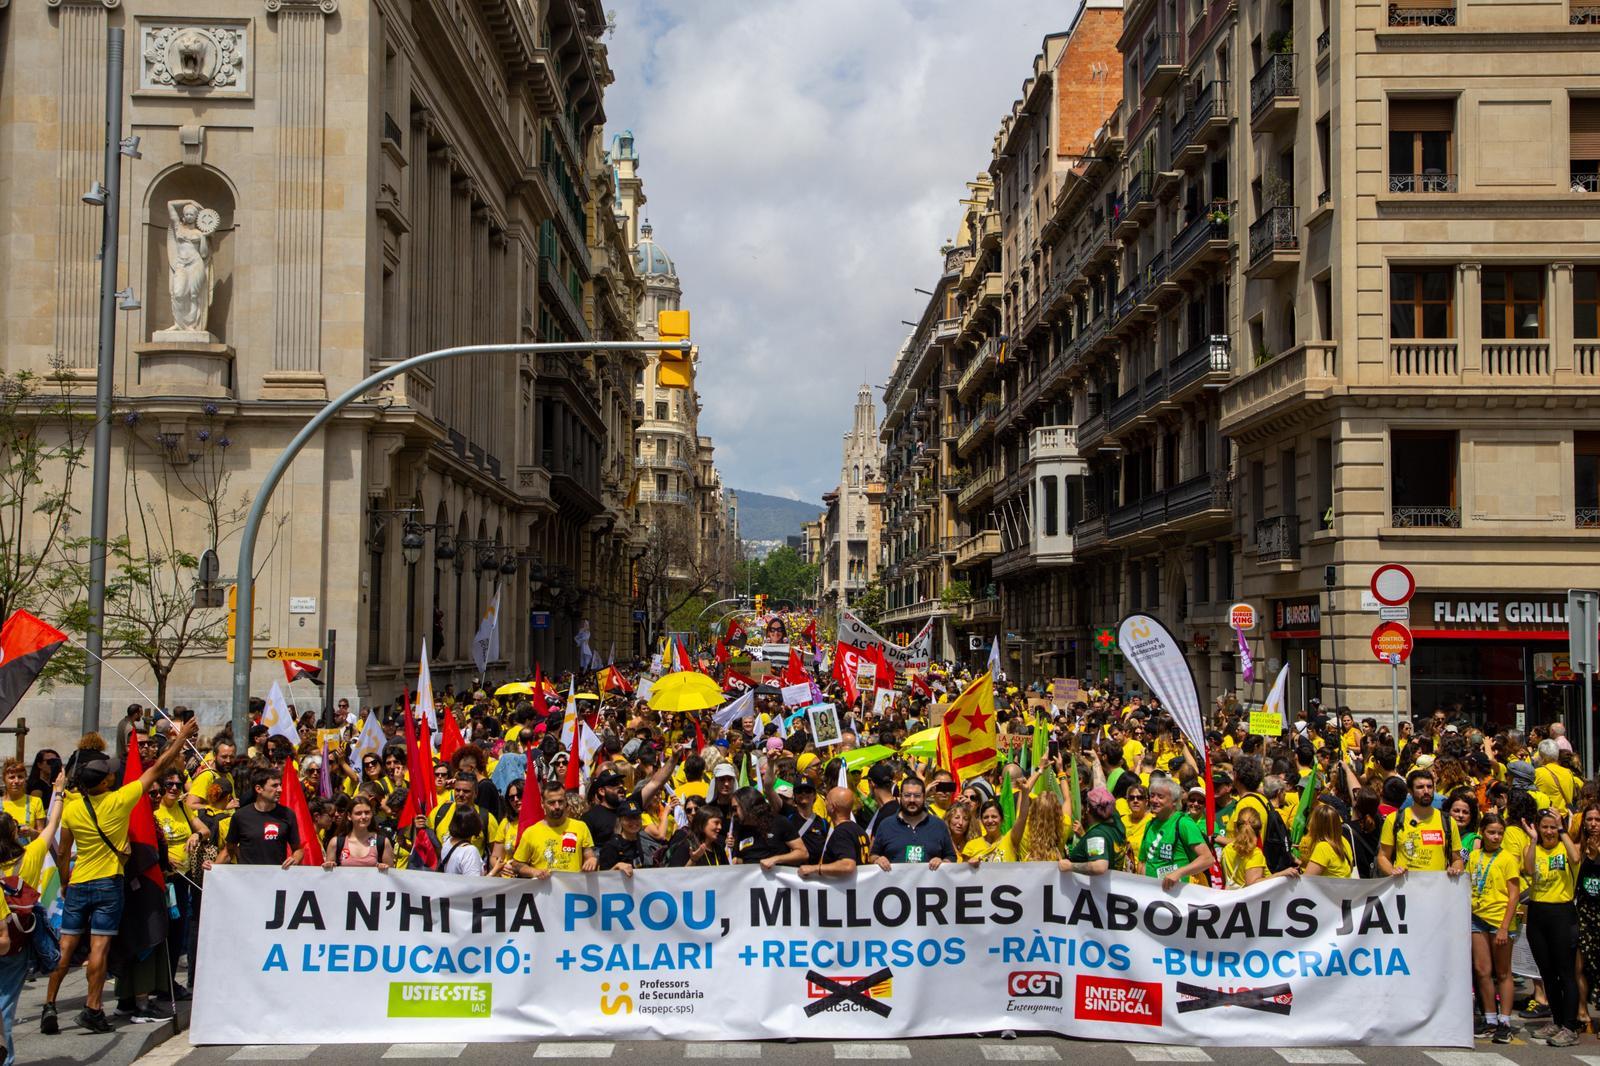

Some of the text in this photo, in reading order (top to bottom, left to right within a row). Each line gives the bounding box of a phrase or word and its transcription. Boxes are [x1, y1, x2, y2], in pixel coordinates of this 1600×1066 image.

[1286, 605, 1310, 625] BURGER
[1434, 602, 1500, 622] FLAME
[299, 617, 305, 627] 6
[728, 676, 752, 695] CGT
[1161, 843, 1173, 851] JO
[265, 885, 1408, 939] JA N'HI HA PROU, MILLORES LABORALS JA!
[262, 929, 1411, 979] A L'EDUCACIÓ: +SALARI +RECURSOS -RÀTIOS -BUROCRÀCIA
[640, 980, 690, 989] Professors
[1012, 974, 1060, 994] CGT
[639, 990, 704, 1000] de Secundària
[1085, 986, 1126, 1000] INTER
[472, 1003, 486, 1013] IAC
[1006, 1000, 1063, 1015] Ensenyament
